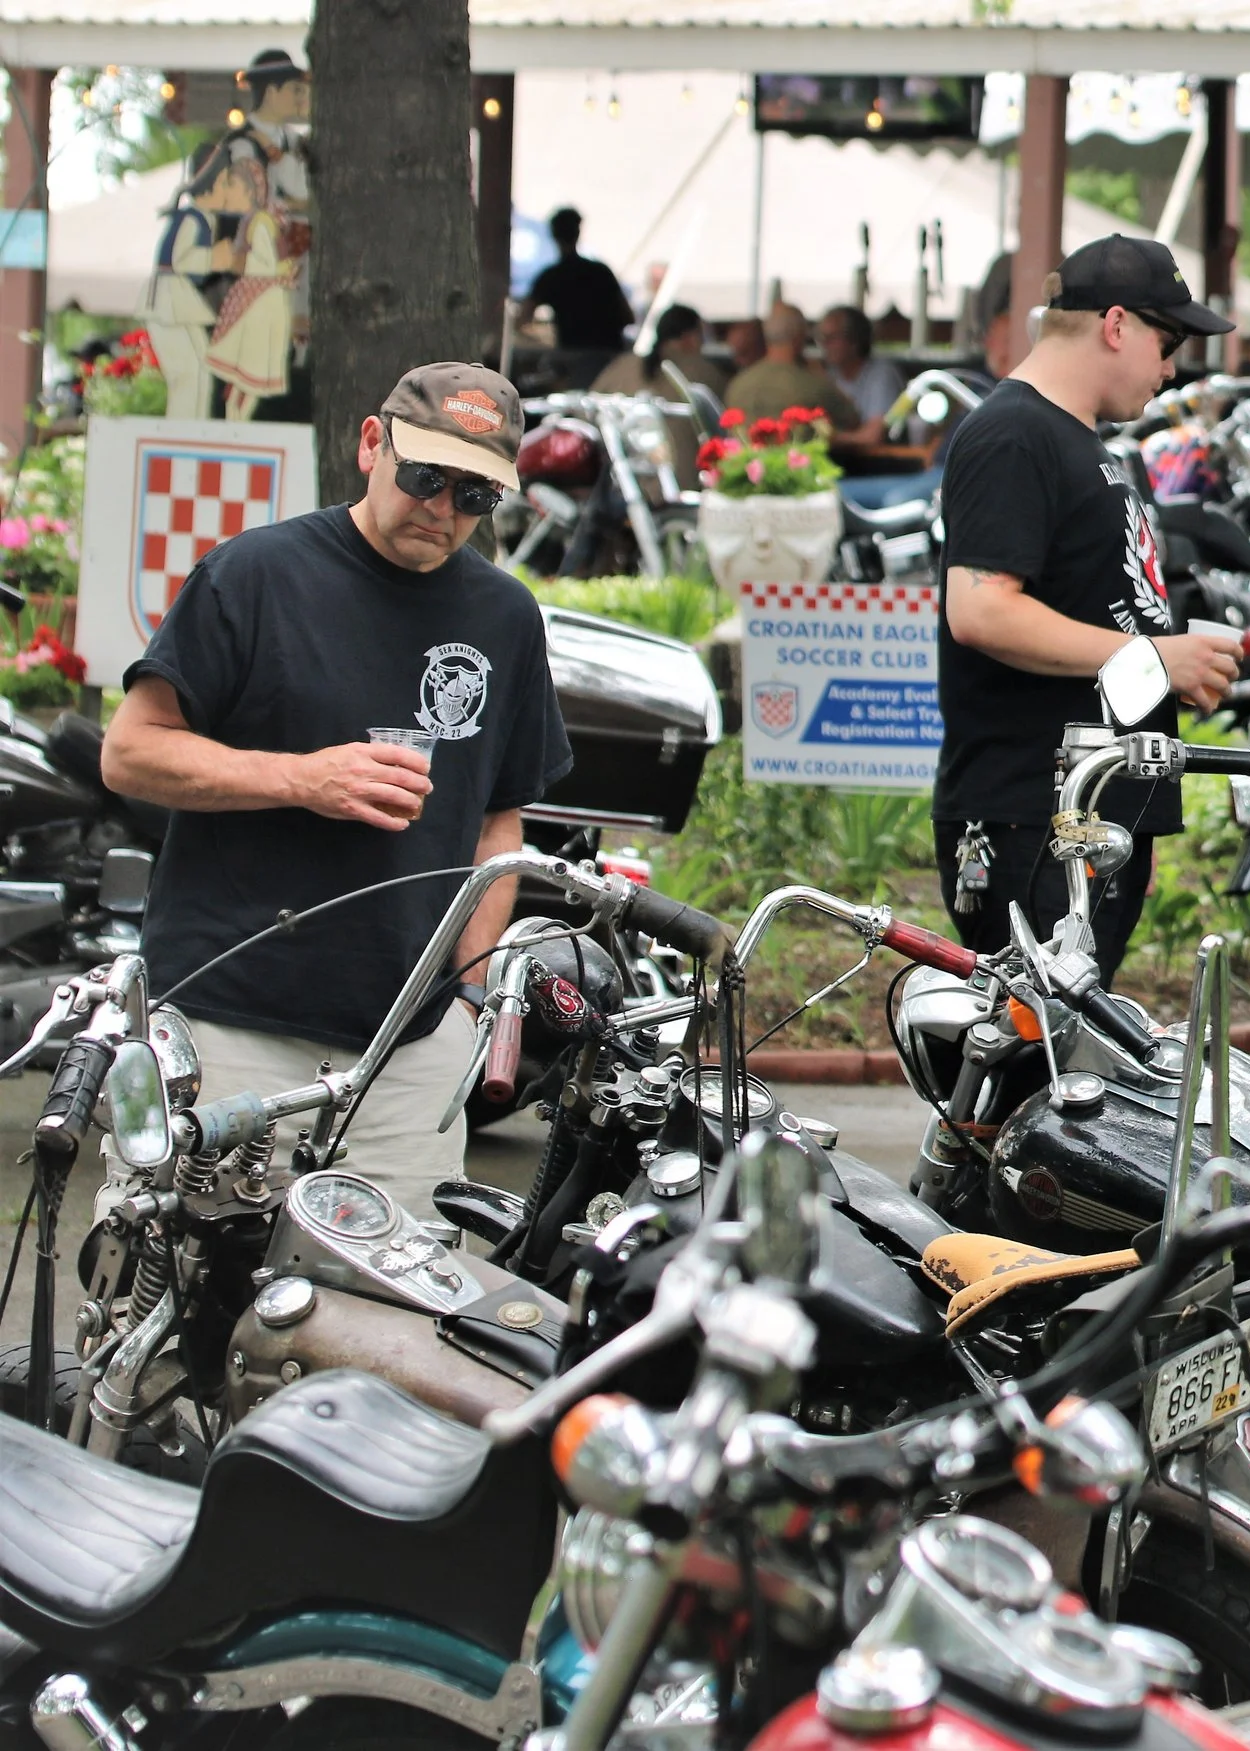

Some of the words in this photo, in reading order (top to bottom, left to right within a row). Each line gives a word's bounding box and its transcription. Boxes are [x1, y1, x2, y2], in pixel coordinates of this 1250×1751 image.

[446, 399, 501, 426] HARLEY-DAVIDSON
[748, 620, 864, 641] CROATIAN
[1113, 609, 1140, 636] AIN
[438, 645, 452, 656] SEA
[454, 645, 484, 664] KNIGHTS
[776, 647, 863, 668] SOCCER
[871, 650, 929, 669] CLUB
[828, 686, 900, 704] Academy
[850, 704, 862, 719] &
[867, 704, 914, 720] Select
[821, 721, 916, 740] Registration
[1168, 1368, 1214, 1420] 866
[1168, 1413, 1199, 1439] APR
